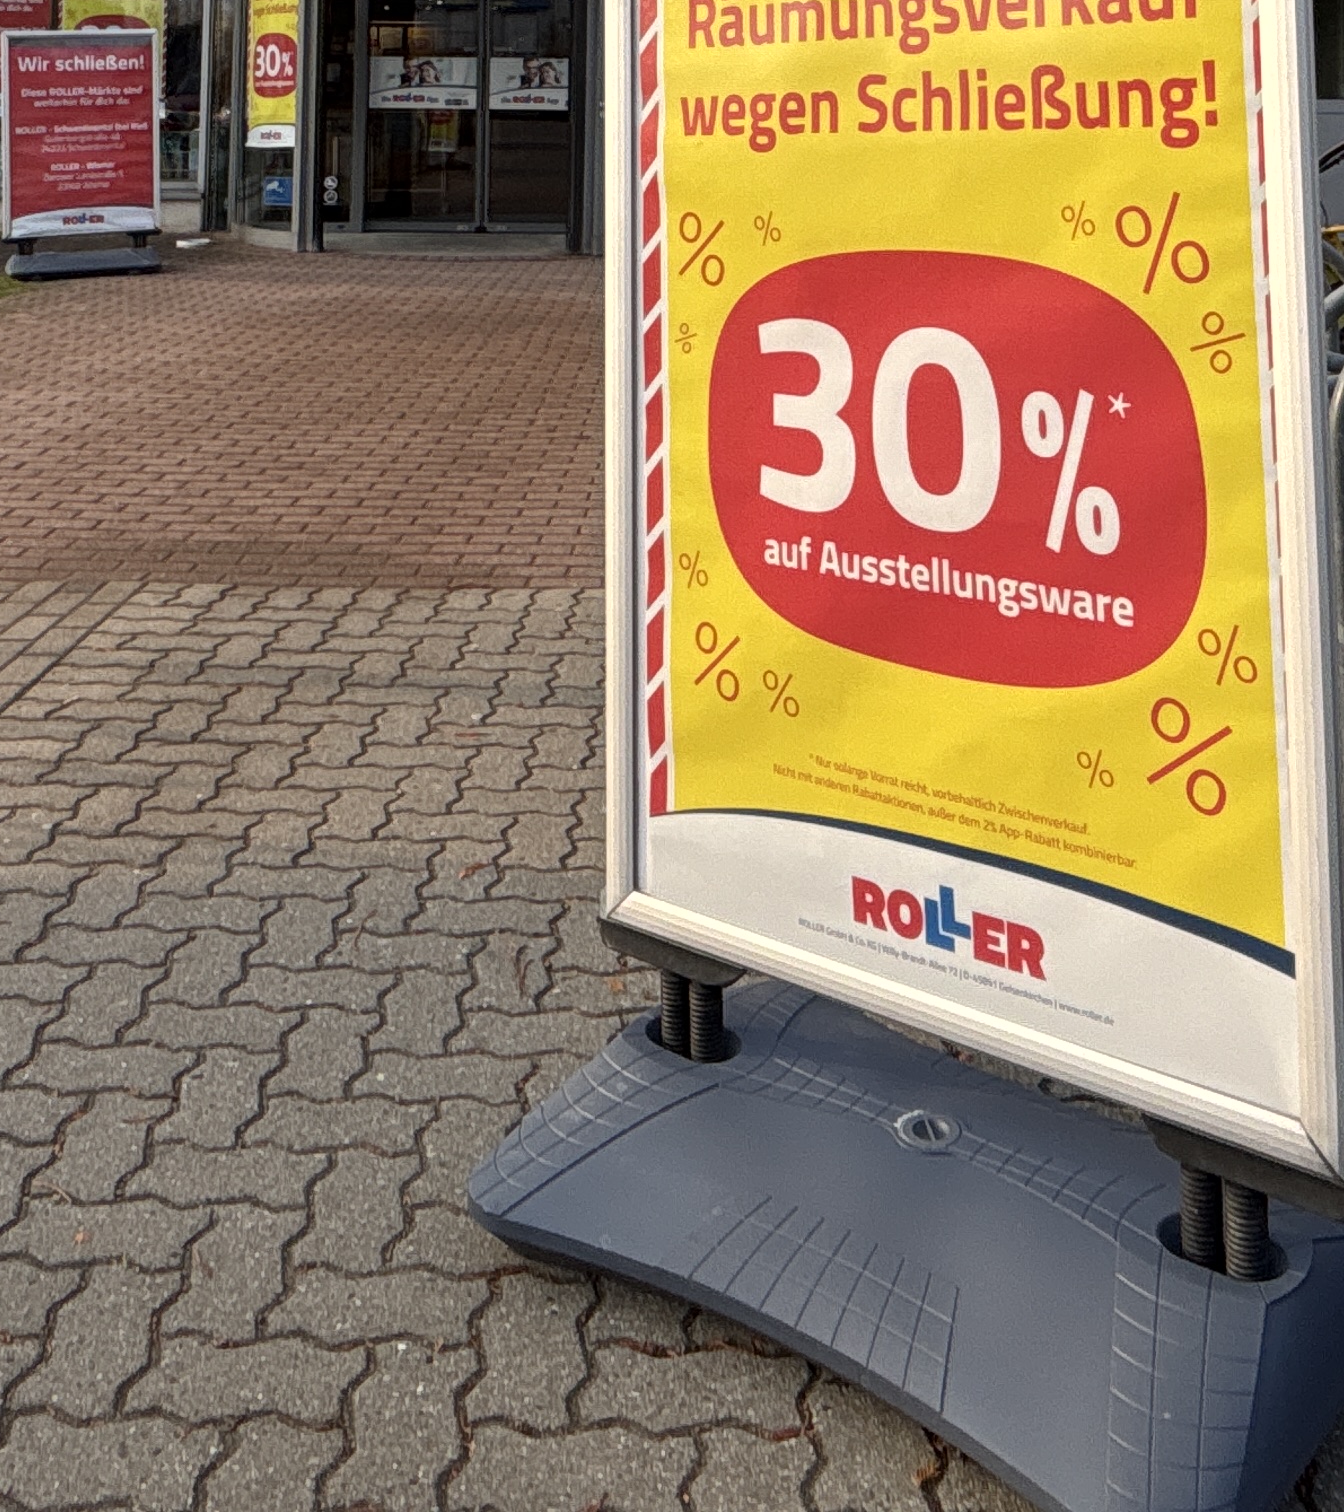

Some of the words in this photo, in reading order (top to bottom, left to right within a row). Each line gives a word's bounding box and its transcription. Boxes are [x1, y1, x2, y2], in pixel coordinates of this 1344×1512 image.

[17, 55, 50, 72] Wir
[55, 54, 145, 72] schließen!
[680, 90, 840, 154] wegen
[856, 59, 1220, 150] Schließung!
[764, 536, 812, 571] auf
[819, 541, 1135, 627] Ausstellungsware
[773, 763, 796, 779] Nicht
[798, 770, 813, 784] mit
[814, 776, 850, 794] anderen
[927, 806, 955, 822] außer
[958, 814, 981, 829] dem
[999, 823, 1061, 850] App-Rabatt
[815, 754, 831, 769] Nur
[833, 762, 869, 780] solange
[870, 770, 899, 787] Vorrat
[852, 875, 1047, 982] ROLLER
